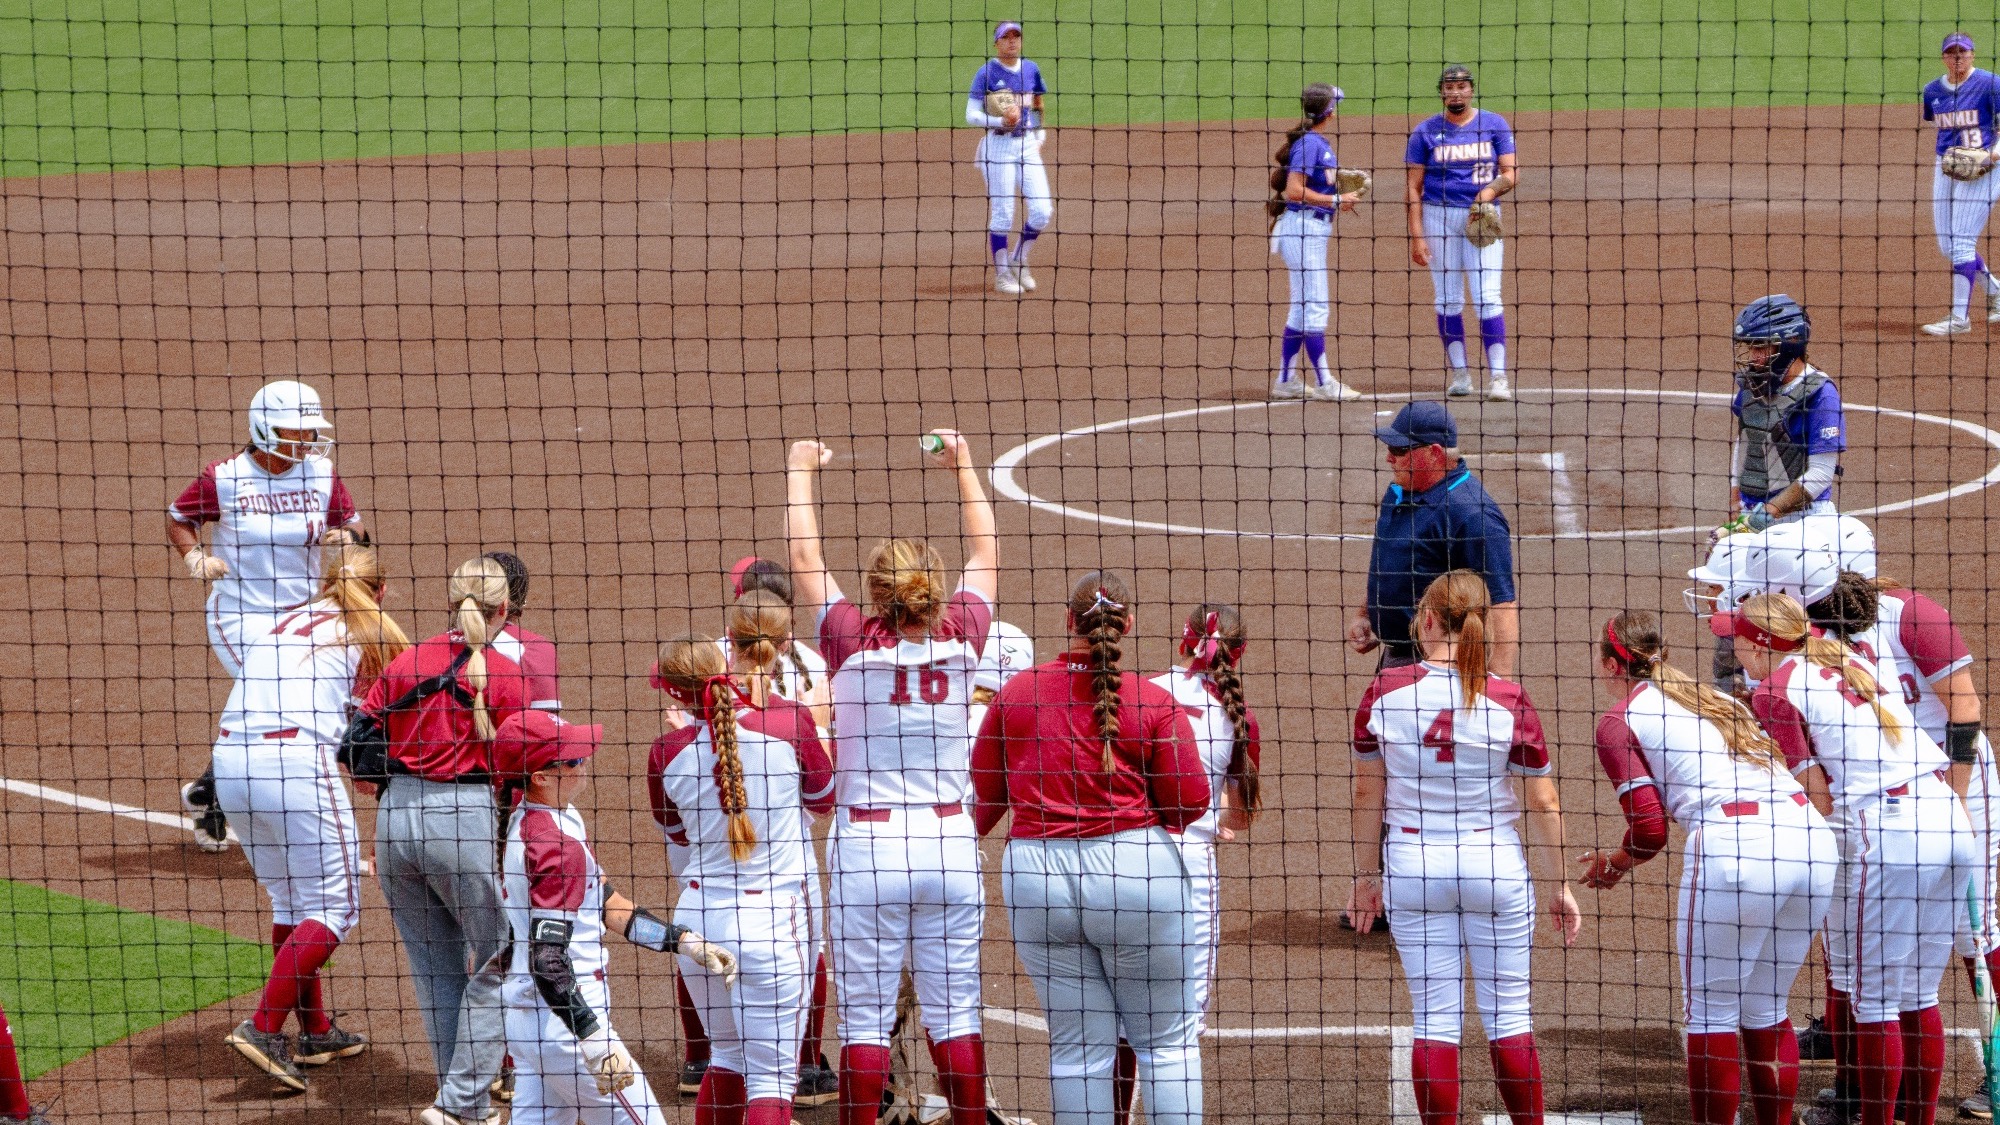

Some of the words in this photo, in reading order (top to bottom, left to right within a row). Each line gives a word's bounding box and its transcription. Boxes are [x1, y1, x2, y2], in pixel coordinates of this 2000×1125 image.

[1961, 127, 1982, 149] 13
[1434, 141, 1492, 162] WNMU
[238, 489, 320, 516] PIONEERS
[1000, 653, 1012, 666] 20
[889, 659, 949, 705] 16
[1423, 708, 1456, 763] 4
